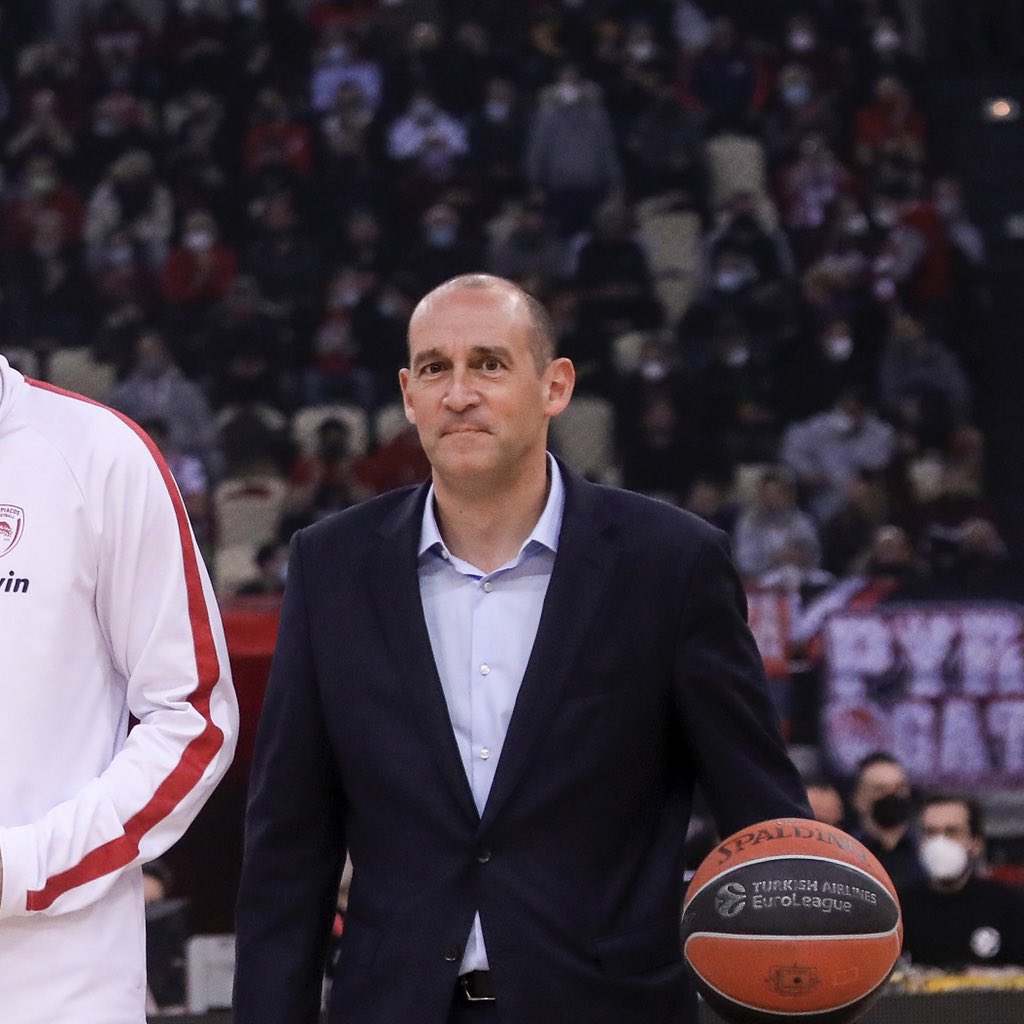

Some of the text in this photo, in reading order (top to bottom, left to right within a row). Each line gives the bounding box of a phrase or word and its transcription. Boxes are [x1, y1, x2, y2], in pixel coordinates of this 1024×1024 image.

[752, 879, 877, 904] TURKISH AIRLINES
[752, 893, 852, 913] EuroLeague
